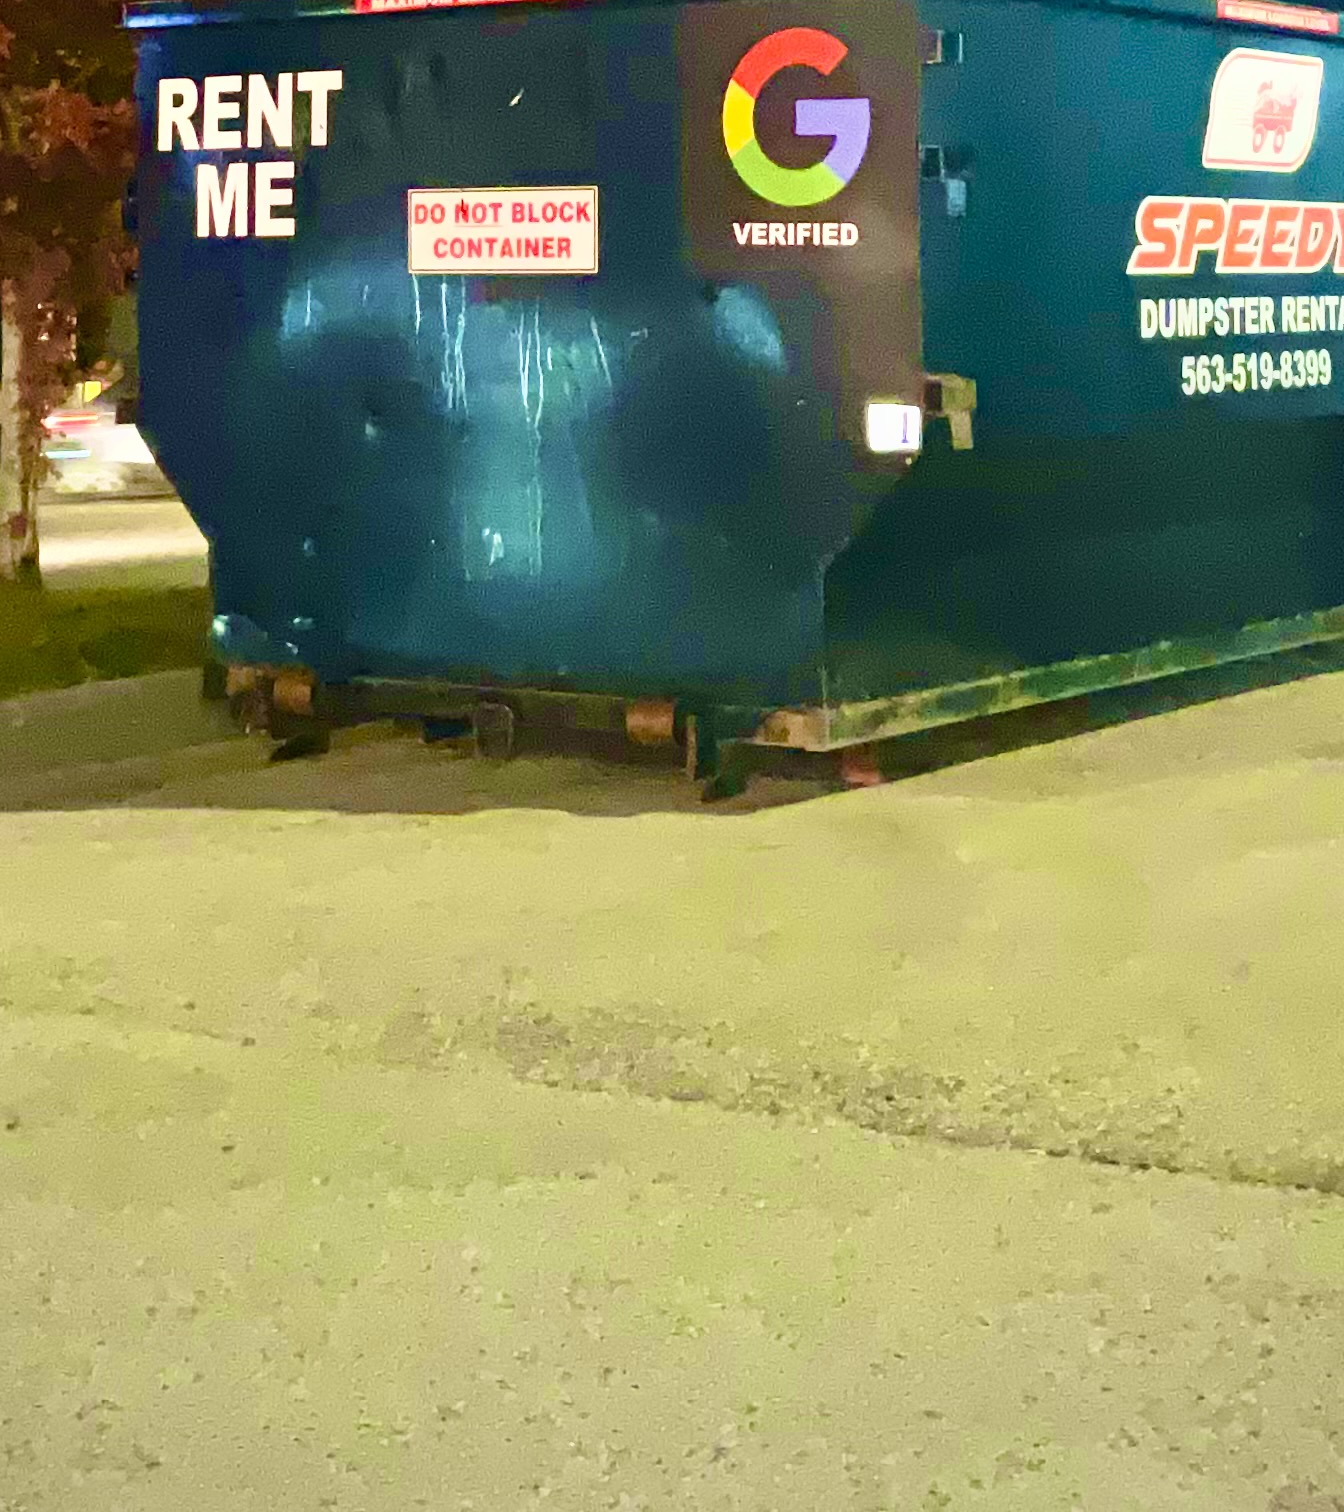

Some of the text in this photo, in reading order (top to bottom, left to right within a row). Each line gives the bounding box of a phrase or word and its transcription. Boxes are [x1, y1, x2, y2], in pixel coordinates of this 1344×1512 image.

[156, 70, 343, 153] RENT
[723, 27, 871, 207] G
[195, 161, 297, 238] ME
[413, 200, 591, 226] DO NOT BLOCK
[433, 235, 572, 259] CONTAINER
[733, 222, 859, 246] VERIFIED
[1140, 297, 1275, 339] DUMPSTER
[1181, 349, 1332, 396] 563-519-8399
